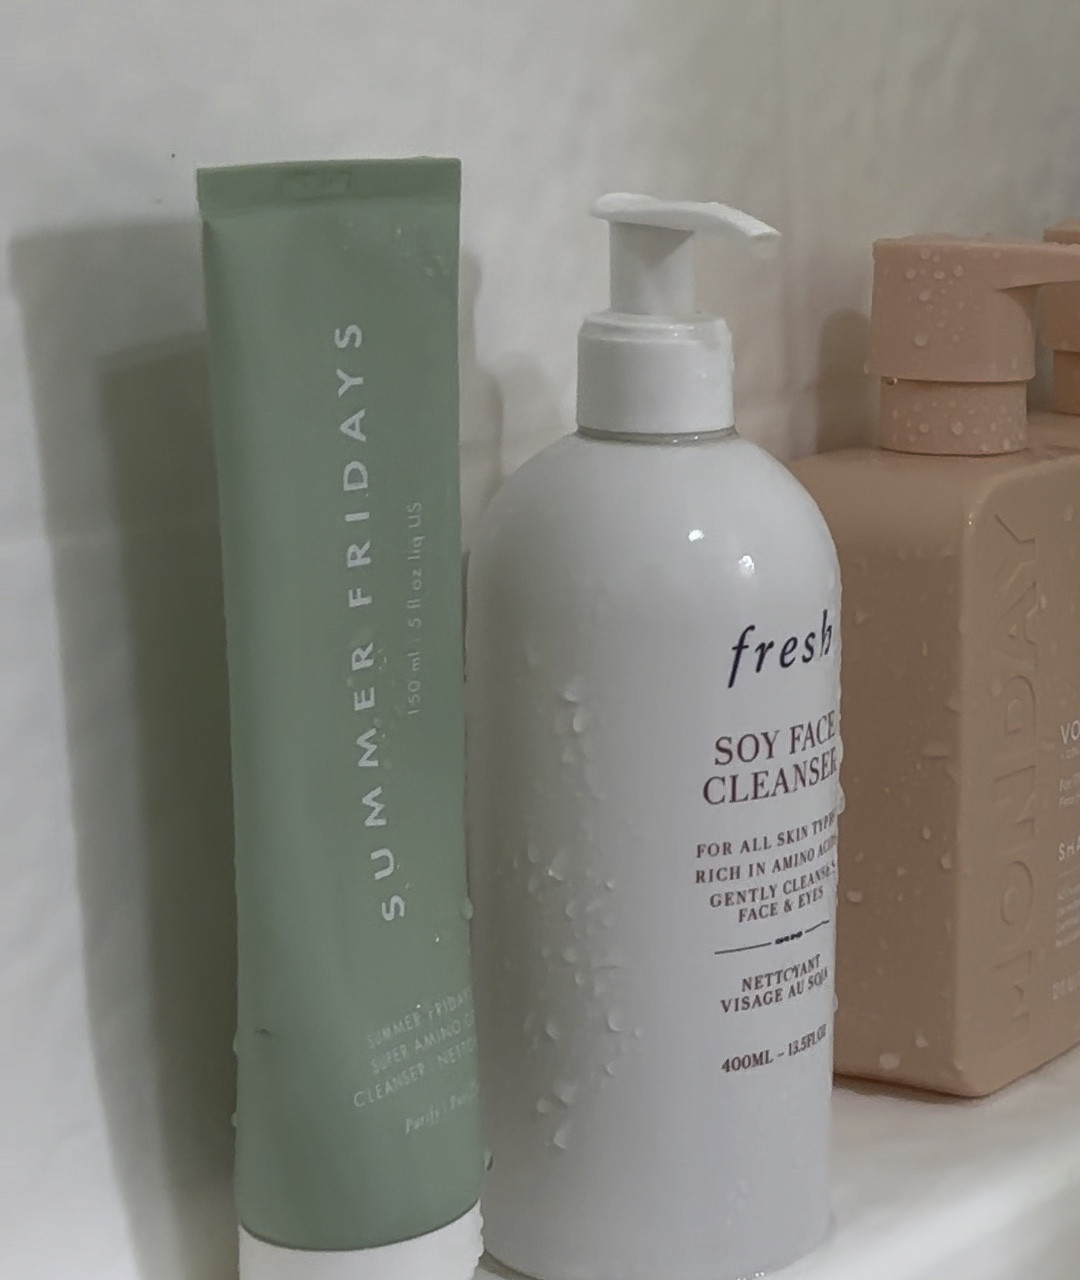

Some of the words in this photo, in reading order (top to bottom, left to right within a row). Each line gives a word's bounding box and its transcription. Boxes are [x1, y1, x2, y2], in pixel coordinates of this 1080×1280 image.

[334, 324, 373, 608] FRIDAYS
[408, 501, 422, 529] US
[407, 535, 426, 561] liq
[412, 567, 422, 591] oz
[727, 608, 833, 689] fresh
[714, 729, 780, 766] SOY
[788, 709, 837, 755] FACE
[351, 641, 405, 922] SUMMER
[696, 841, 733, 859] FOR
[739, 835, 772, 855] ALL
[776, 824, 809, 847] SKIN
[695, 864, 741, 884] RICH
[748, 861, 766, 878] IN
[771, 847, 815, 874] AMINO
[709, 883, 778, 908] GENTLY
[737, 901, 779, 924] FACE
[783, 898, 793, 913] &
[797, 885, 824, 909] EYES
[741, 953, 821, 993] NETTOYANT
[720, 987, 784, 1014] VISAGE
[787, 980, 805, 999] AU
[720, 1049, 774, 1073] 400ML
